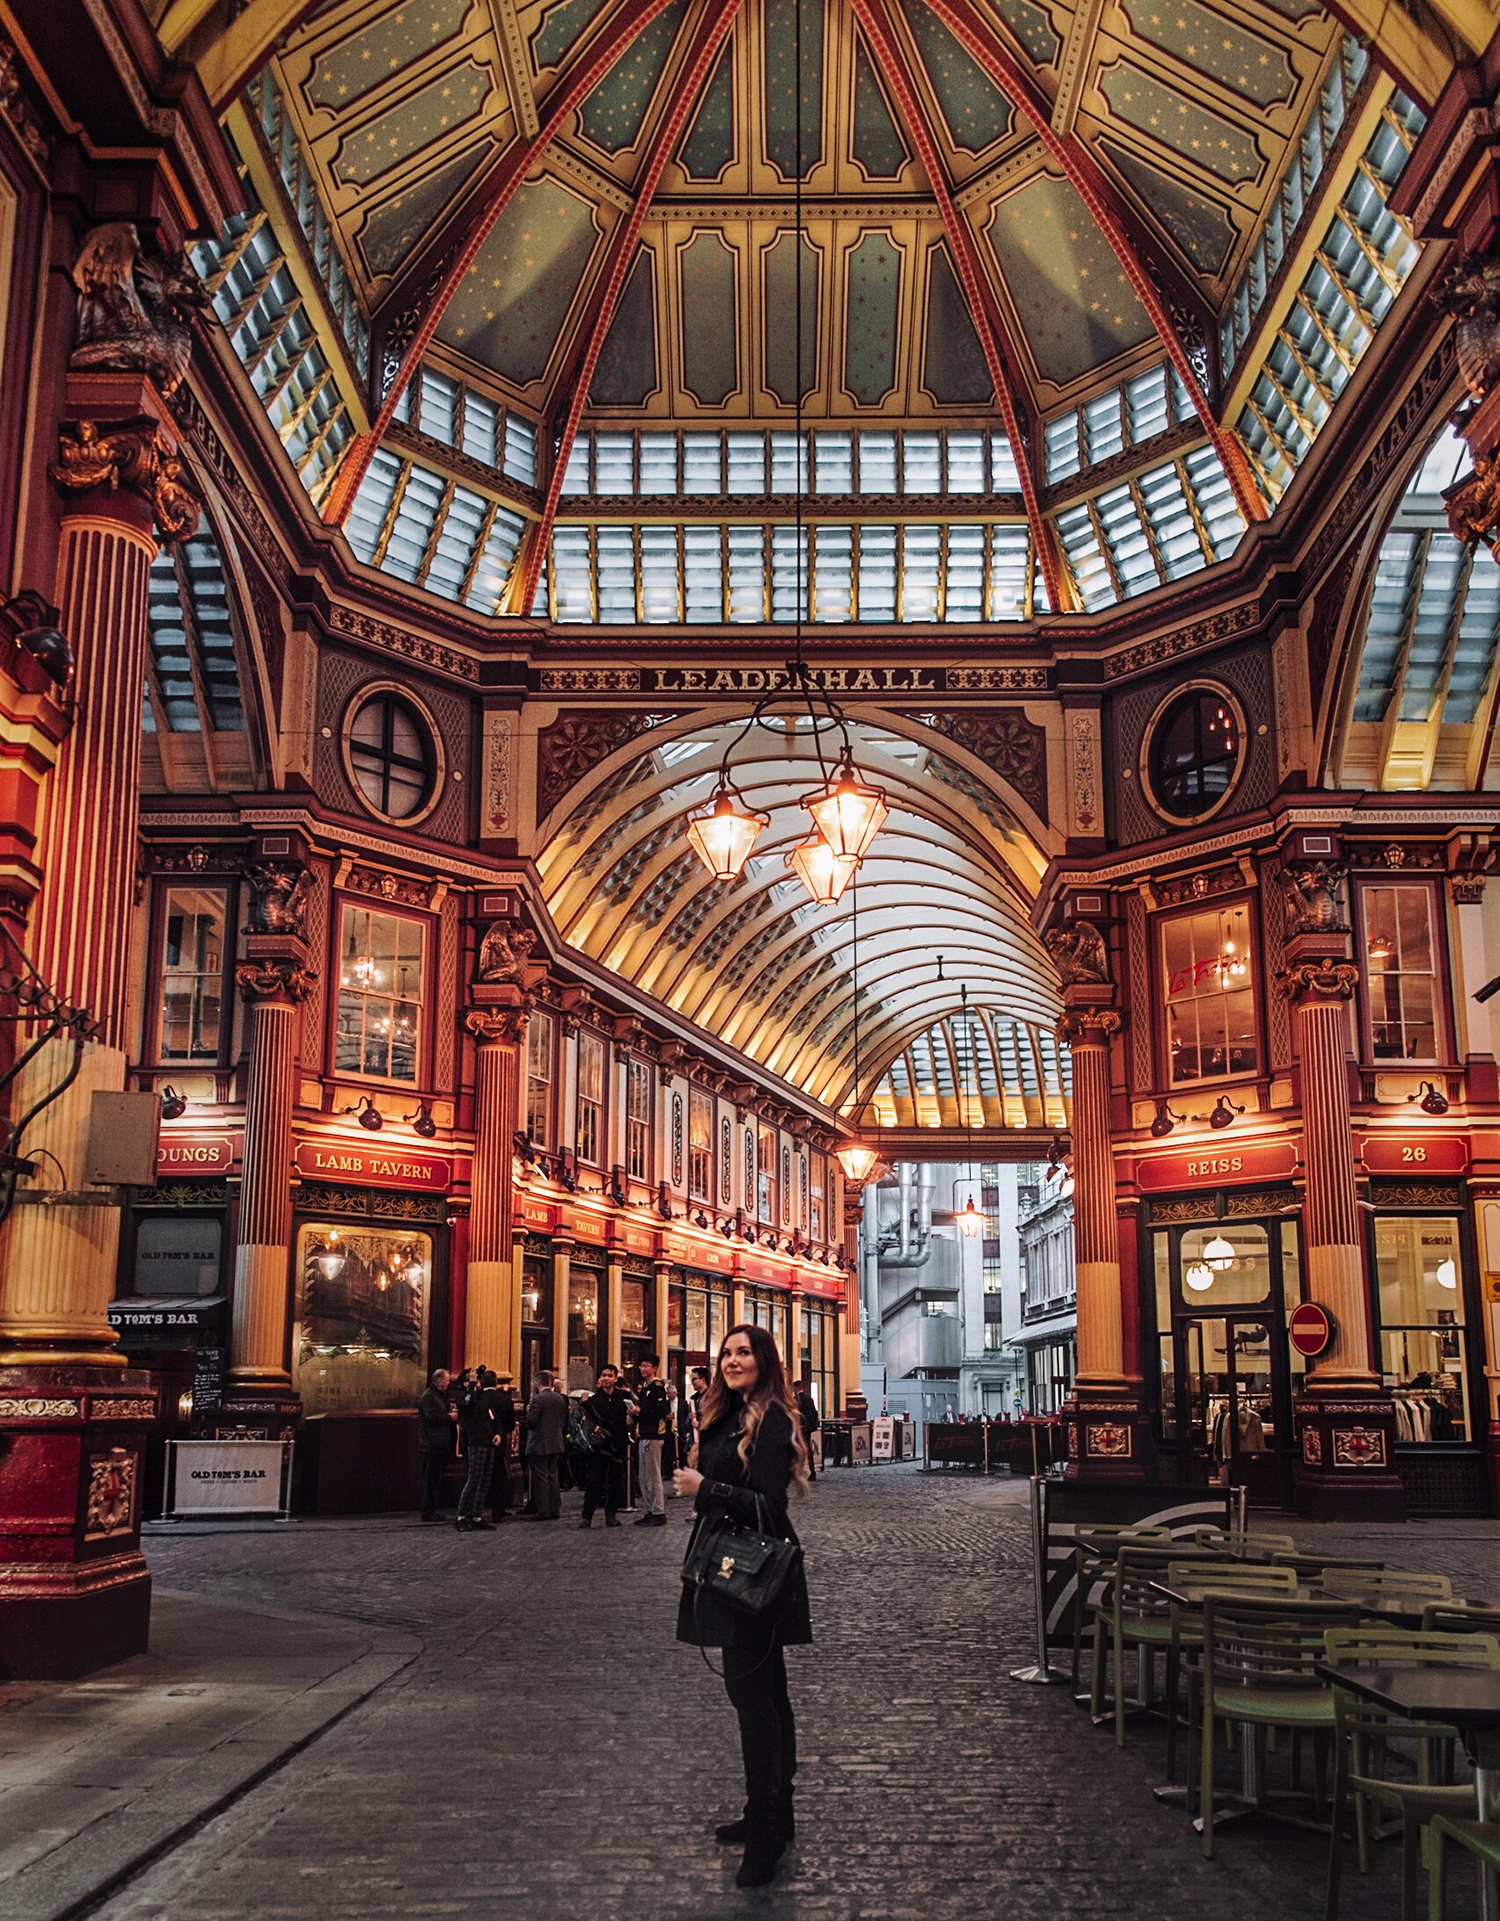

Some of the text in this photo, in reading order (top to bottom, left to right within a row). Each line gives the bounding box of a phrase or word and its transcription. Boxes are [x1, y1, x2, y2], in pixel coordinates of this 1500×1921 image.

[654, 669, 935, 691] LEADENHALL
[1402, 1147, 1426, 1162] 26
[315, 1153, 433, 1180] LAMB TAVERN
[1187, 1157, 1243, 1176] REISS
[525, 1208, 548, 1223] LAMB
[575, 1220, 600, 1236] TAVERN
[141, 1252, 215, 1260] OLD TOM'S BAR
[124, 1314, 164, 1325] TOM'S
[166, 1313, 199, 1325] BAR
[191, 1470, 266, 1479] OLD TOM'S BAR
